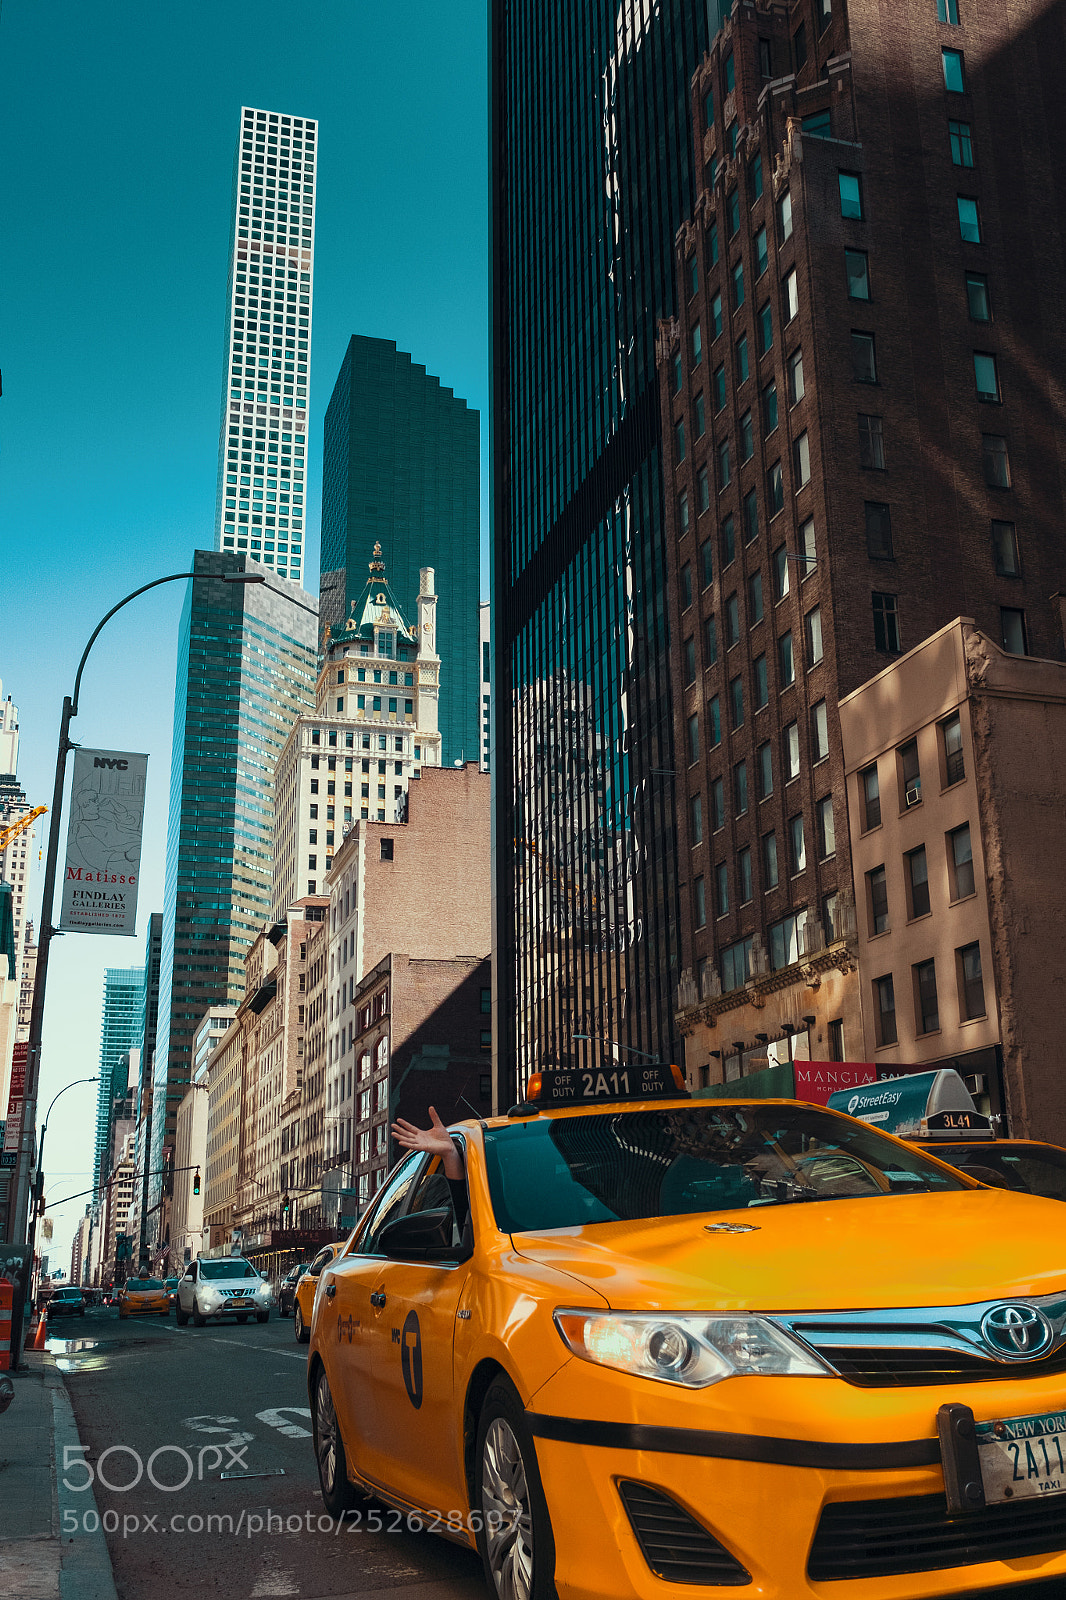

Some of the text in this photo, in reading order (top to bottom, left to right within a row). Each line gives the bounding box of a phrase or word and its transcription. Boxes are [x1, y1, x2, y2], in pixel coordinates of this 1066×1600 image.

[94, 757, 128, 771] NYC
[66, 866, 136, 885] Matisse
[73, 890, 126, 902] FINDLAY
[72, 900, 126, 910] GALLERIES
[69, 920, 124, 928] findlaygalleries.com
[554, 1075, 572, 1086] OFF
[642, 1070, 660, 1081] OFF
[798, 1070, 873, 1084] MANGIA
[582, 1071, 630, 1096] 2A11
[641, 1081, 664, 1092] DUTY
[552, 1087, 575, 1098] DUTY
[857, 1091, 902, 1109] StreetEasy
[943, 1114, 971, 1128] 3L41
[1004, 1420, 1035, 1440] NEW
[1007, 1435, 1065, 1481] 2A11
[1038, 1479, 1061, 1491] TAXI
